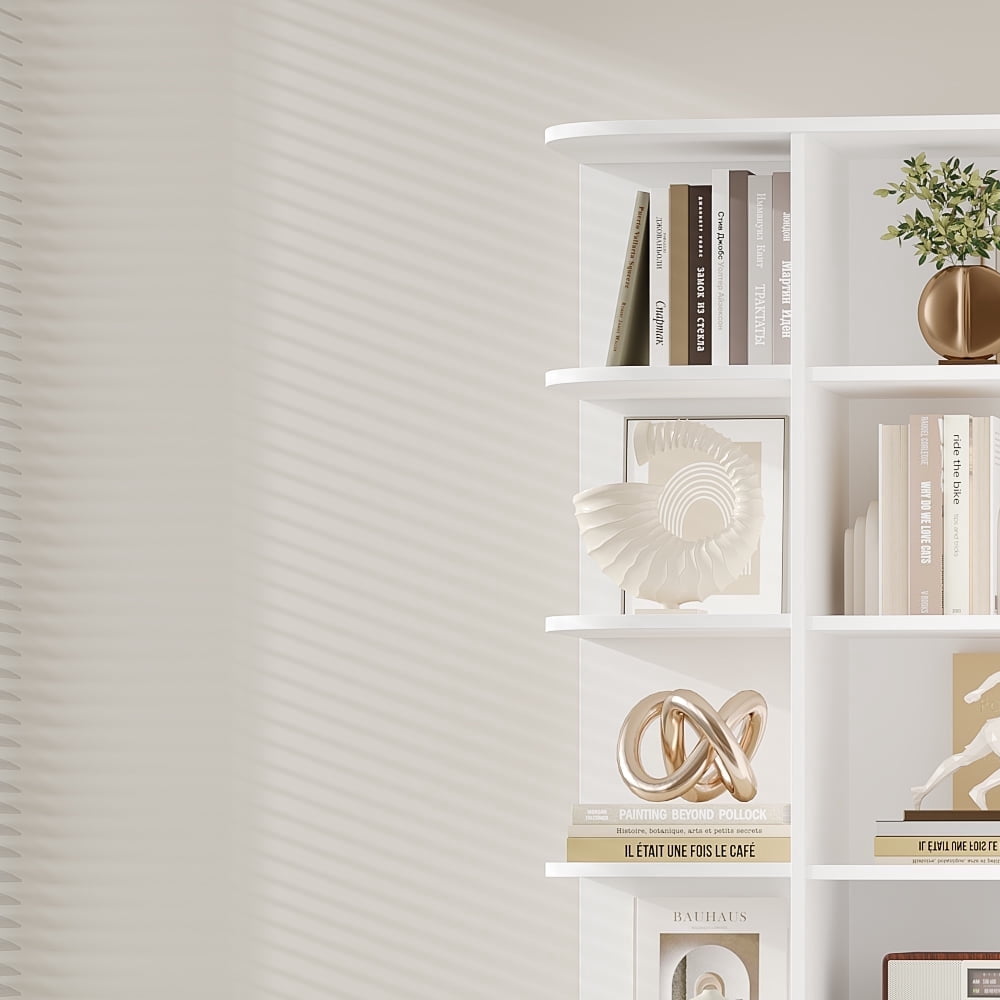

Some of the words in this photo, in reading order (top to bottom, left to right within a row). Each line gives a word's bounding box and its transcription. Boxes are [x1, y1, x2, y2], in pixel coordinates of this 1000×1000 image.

[717, 211, 725, 230] Стив
[717, 232, 725, 260] Джобс
[653, 301, 666, 346] Спартак
[952, 434, 962, 456] ride
[952, 460, 962, 478] the
[952, 481, 962, 505] bike
[619, 809, 667, 820] PAINTING
[672, 809, 715, 820] BEYOND
[719, 809, 767, 820] POLLOCK
[625, 845, 634, 857] IL
[637, 842, 664, 857] ÉTAIT
[667, 845, 687, 857] UNE
[690, 845, 712, 857] FOIS
[715, 845, 726, 857] LE
[730, 842, 755, 857] CAFÉ
[674, 911, 747, 922] BAUHAUS
